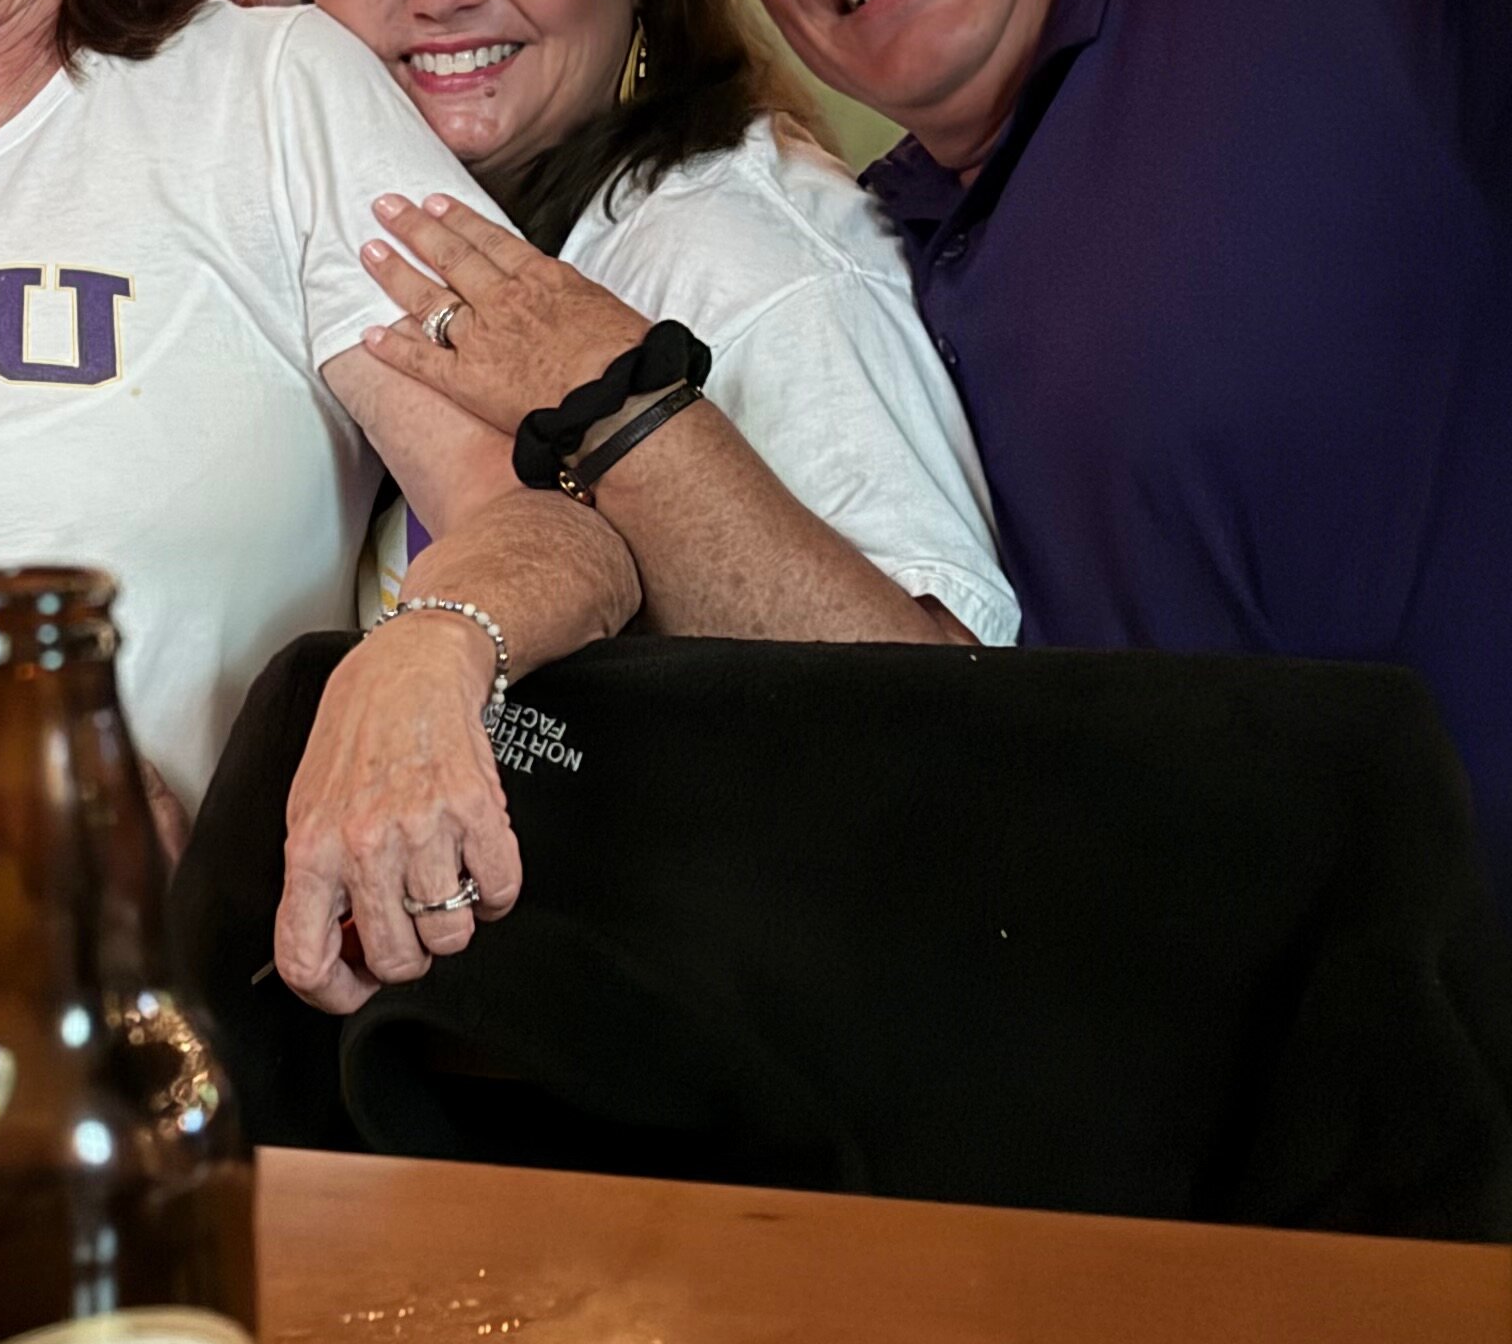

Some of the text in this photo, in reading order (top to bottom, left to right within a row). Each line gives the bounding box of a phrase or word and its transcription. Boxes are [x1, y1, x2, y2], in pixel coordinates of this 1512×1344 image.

[504, 702, 567, 741] FACE
[492, 741, 535, 774] THE
[495, 720, 584, 773] NORTH
